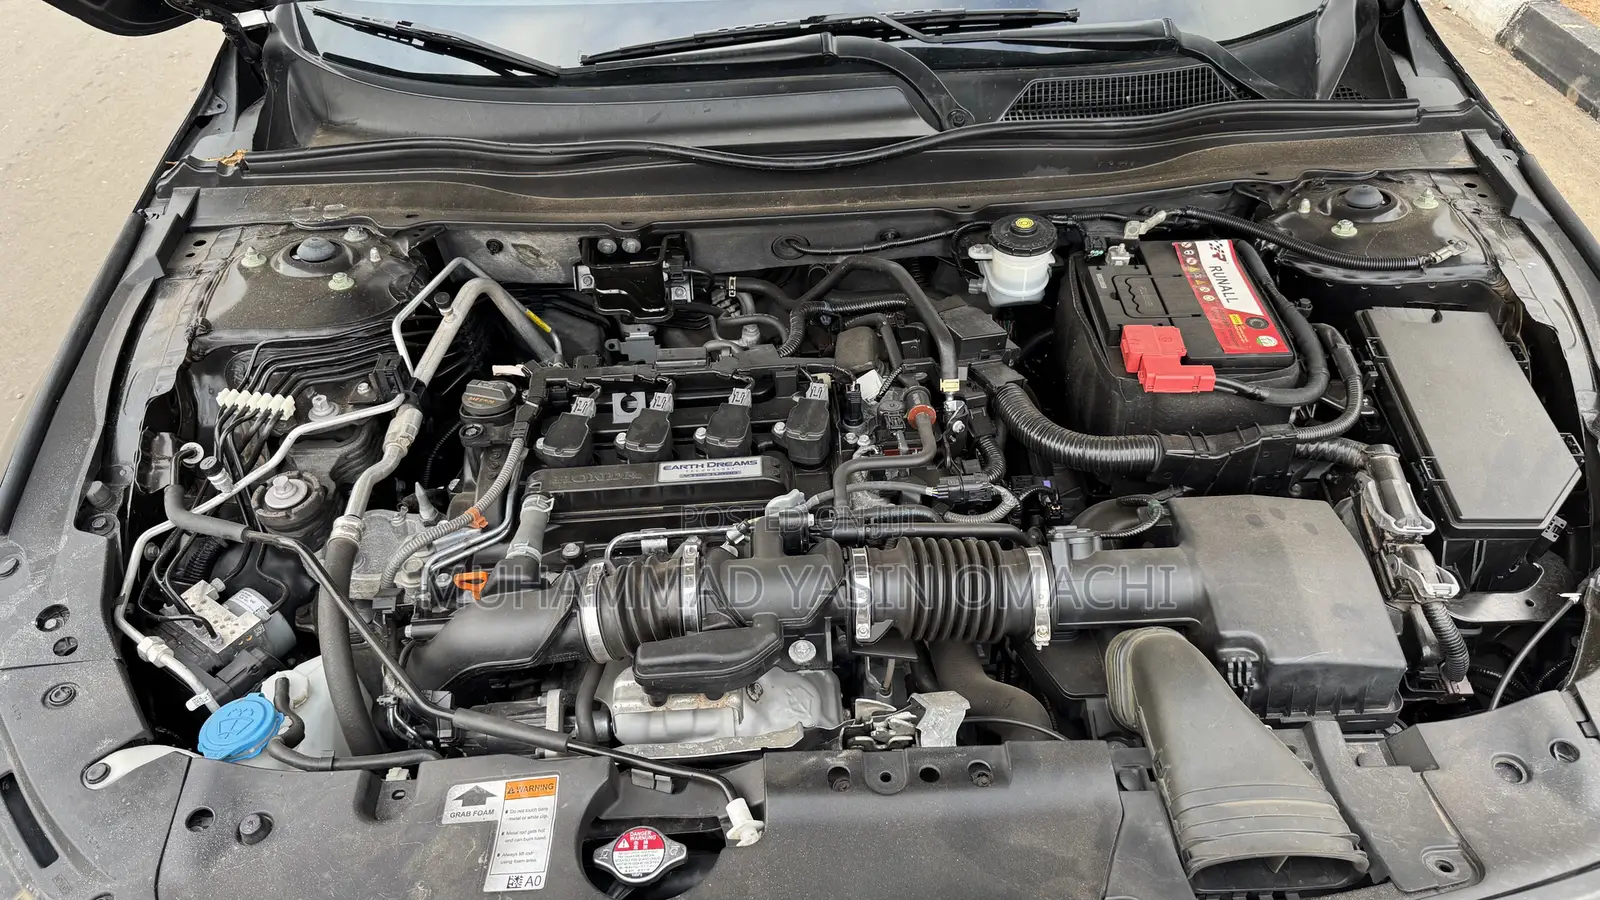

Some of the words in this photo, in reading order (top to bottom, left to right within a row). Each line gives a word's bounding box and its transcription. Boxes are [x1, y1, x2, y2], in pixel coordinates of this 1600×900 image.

[1208, 265, 1239, 304] RUNALL
[662, 463, 704, 471] EARTH
[706, 460, 758, 468] DREAMS
[516, 783, 554, 793] WARNING
[449, 810, 471, 819] GRAB
[472, 808, 495, 817] FOAM
